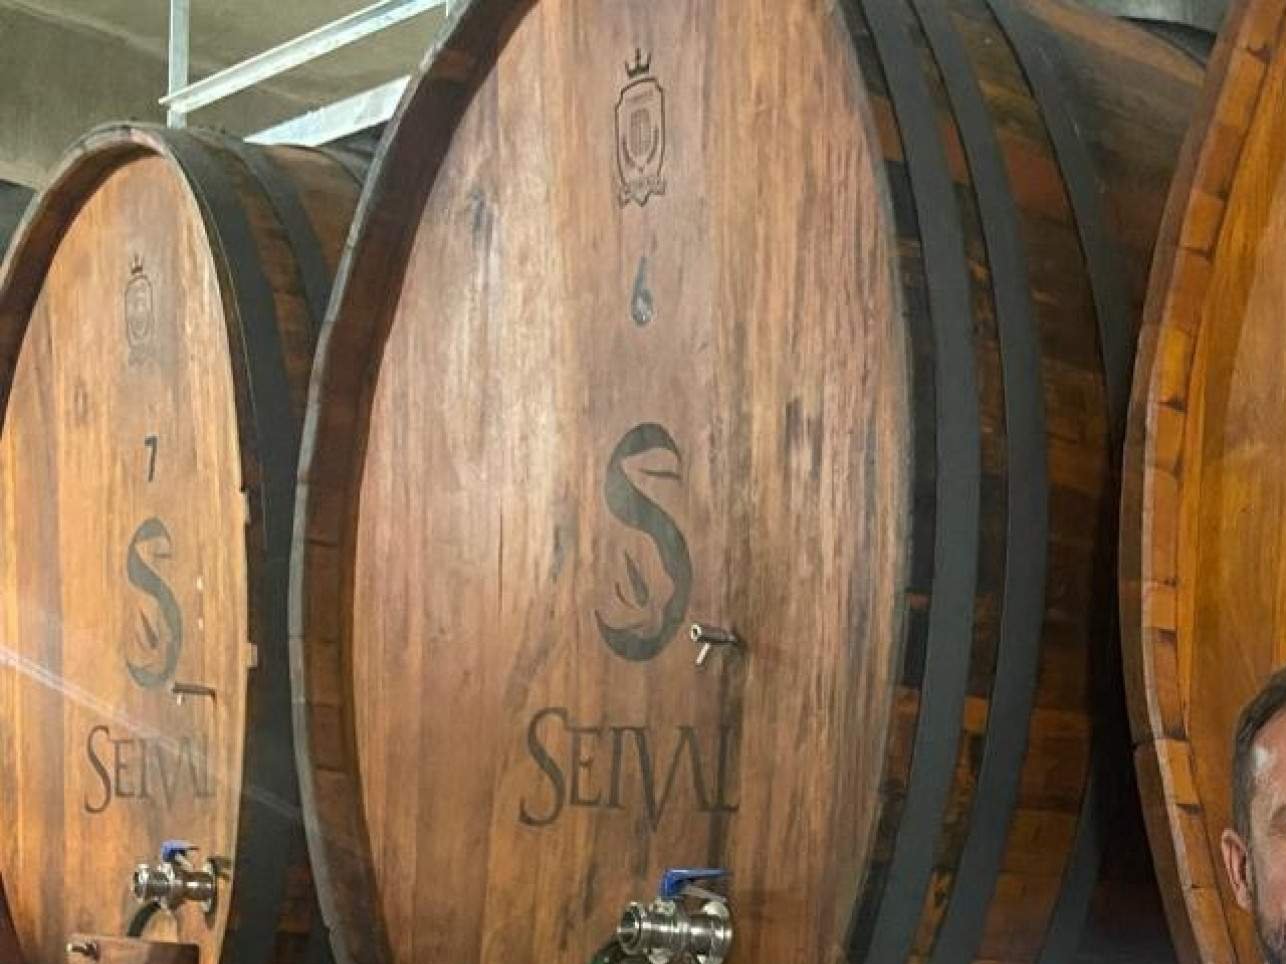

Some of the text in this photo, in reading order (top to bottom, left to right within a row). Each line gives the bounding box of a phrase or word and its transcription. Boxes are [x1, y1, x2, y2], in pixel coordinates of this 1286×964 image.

[630, 254, 655, 328] 6
[84, 724, 217, 815] SEIVAL
[519, 706, 741, 833] SEIVAL
